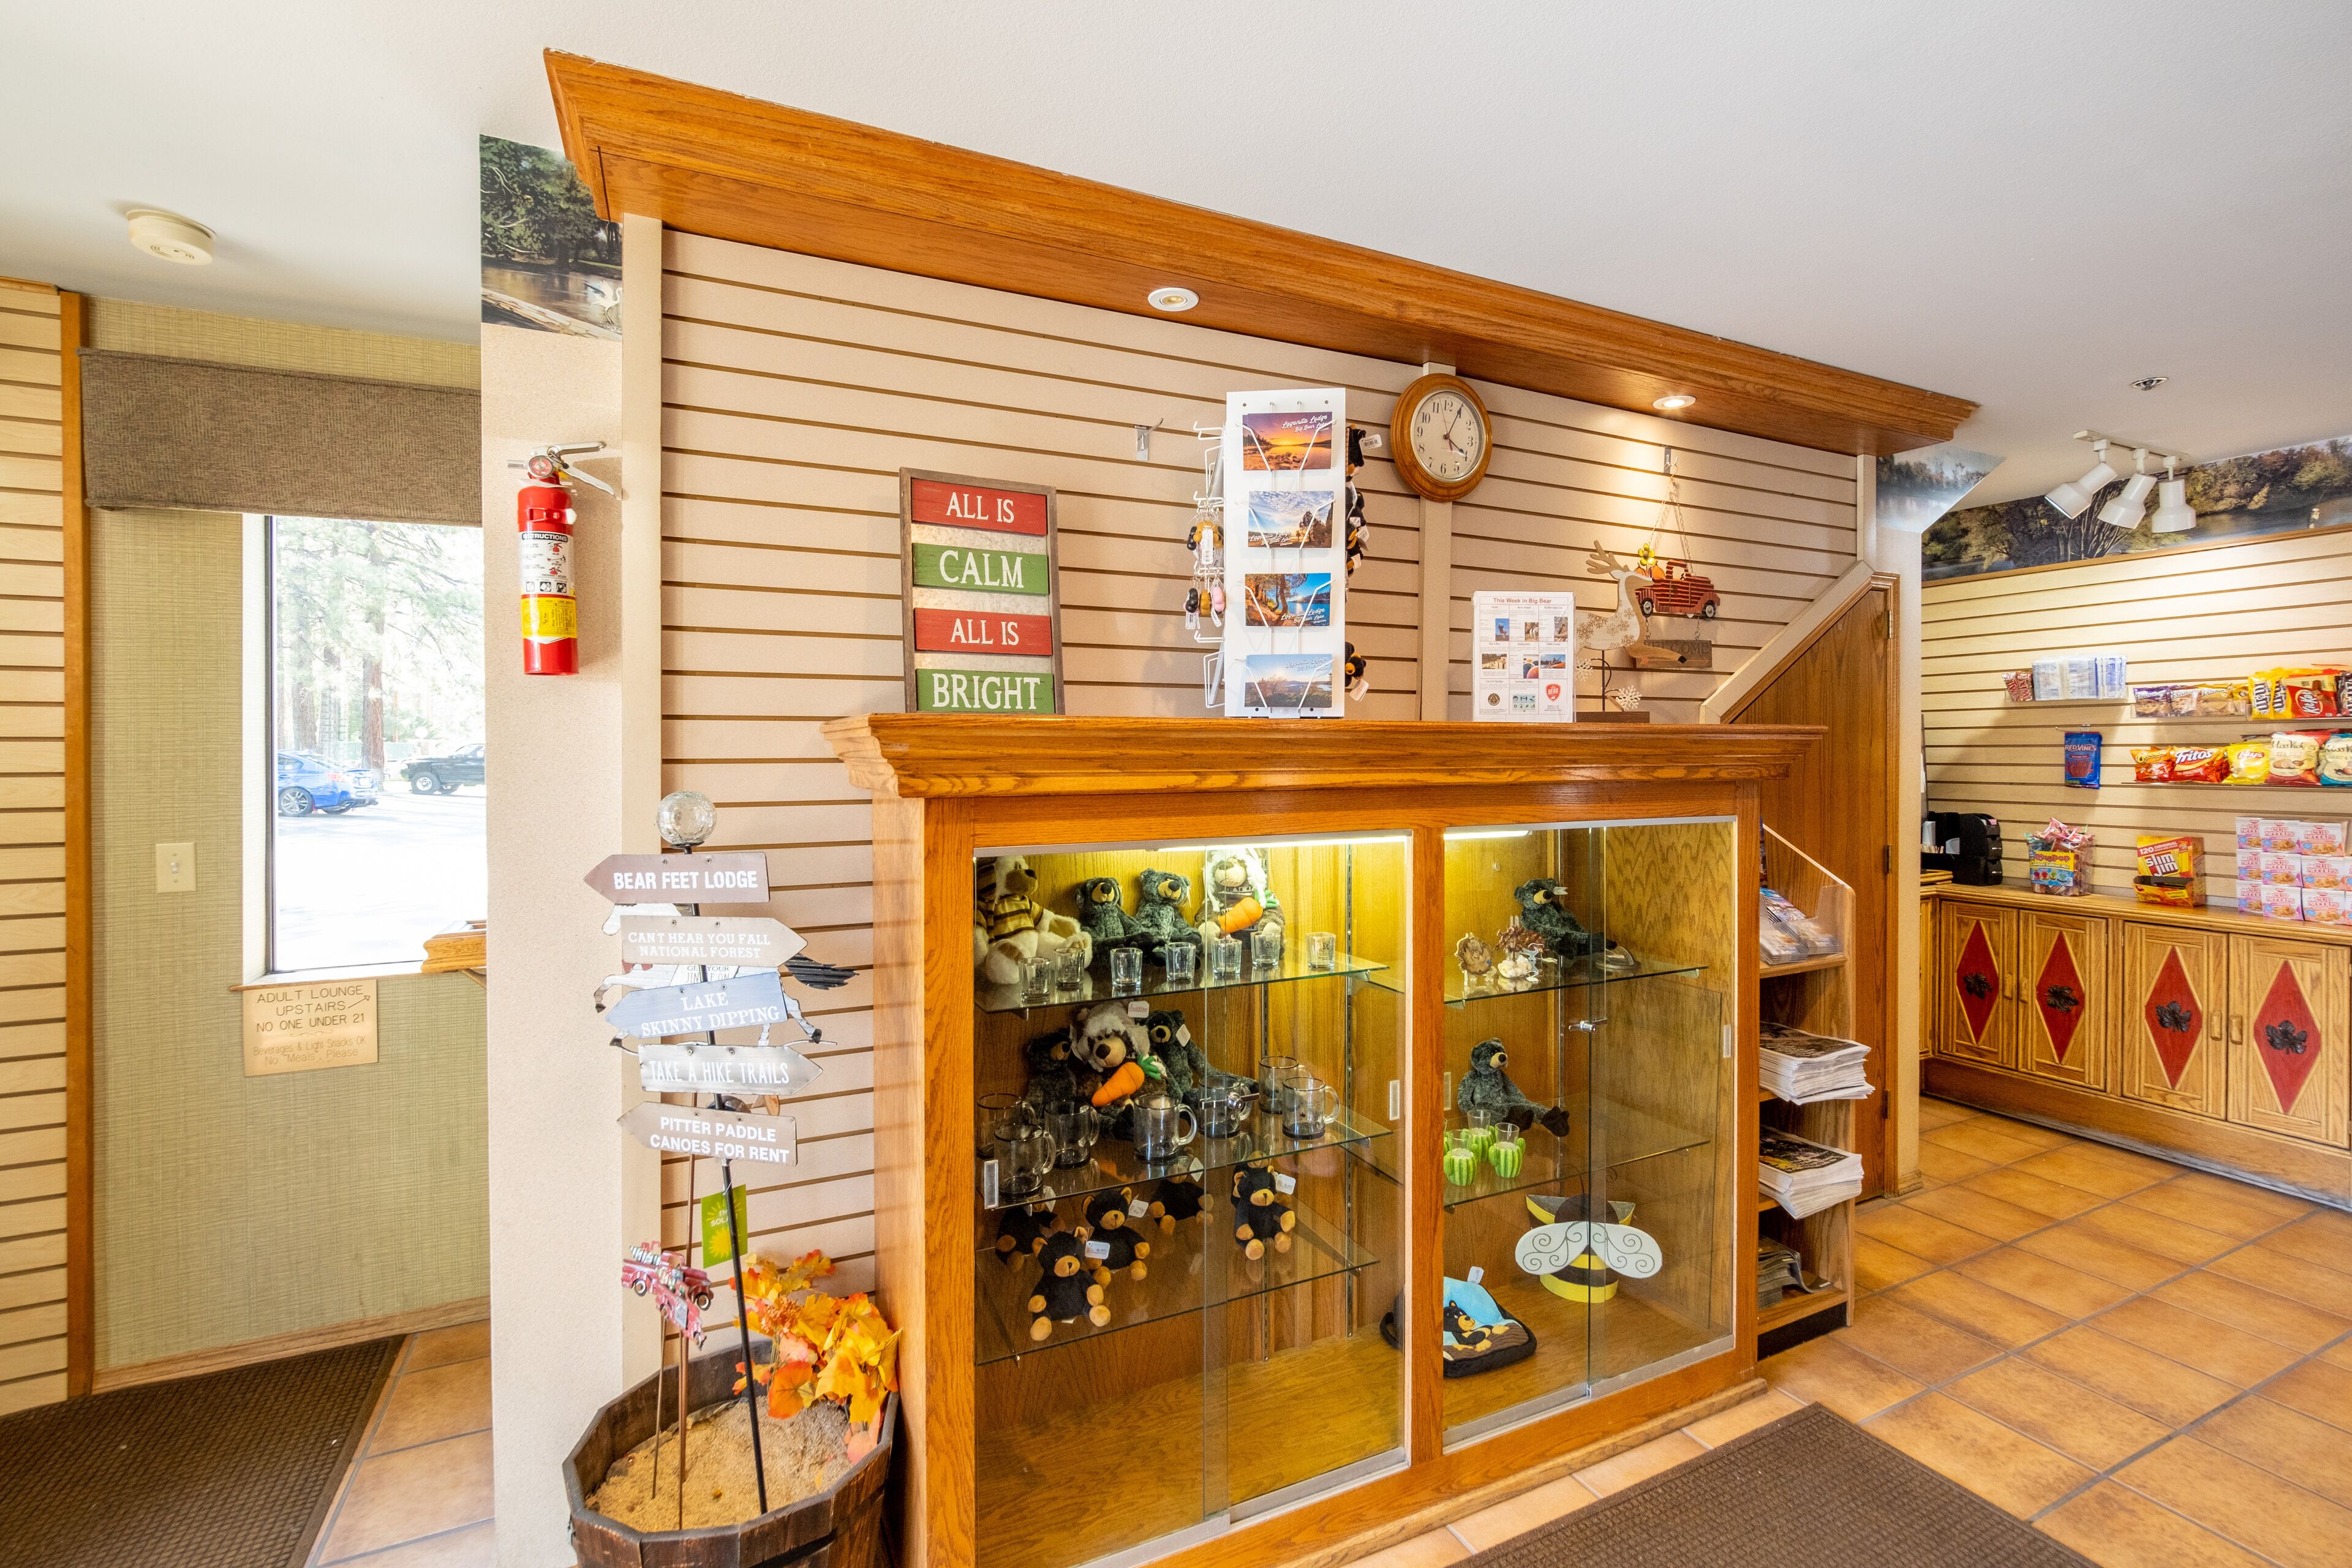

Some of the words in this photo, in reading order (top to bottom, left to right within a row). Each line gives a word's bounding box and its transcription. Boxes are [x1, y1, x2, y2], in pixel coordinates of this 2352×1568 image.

[1433, 402, 1439, 413] 11
[1444, 400, 1453, 412] 12
[1421, 412, 1431, 424] 10
[1466, 420, 1471, 430] 2
[1417, 426, 1423, 437] 9
[1419, 443, 1425, 454] 8
[1467, 436, 1473, 447] 3
[1428, 457, 1433, 468] 7
[1440, 463, 1446, 474] 6
[1454, 461, 1459, 472] 5
[945, 492, 989, 520] ALL
[997, 498, 1014, 523] IS
[939, 550, 1024, 589] CALM
[950, 618, 993, 646] ALL
[1001, 621, 1019, 646] IS
[932, 673, 1040, 710] BRIGHT
[2175, 750, 2213, 764] Fritos
[2139, 846, 2154, 855] 120
[614, 872, 656, 889] BEAR
[662, 871, 699, 889] FEET
[704, 870, 758, 889] LODGE
[628, 930, 666, 944] CAN'T
[668, 933, 705, 945] HEAR
[707, 933, 735, 945] YOU
[738, 933, 771, 946] FALL
[639, 945, 707, 958] NATIONAL
[710, 946, 761, 959] FOREST
[686, 973, 715, 983] JINE
[257, 990, 304, 1003] ADULT
[311, 985, 363, 999] LOUNGE
[680, 992, 729, 1011] LAKE
[276, 1001, 345, 1016] UPSTAIRS
[257, 1022, 273, 1032] NO
[279, 1019, 303, 1030] ONE
[309, 1014, 347, 1027] UNDER
[353, 1012, 364, 1023] 21
[640, 1016, 704, 1037] SKINNY
[709, 1006, 780, 1028] DIPPING
[254, 1046, 293, 1056] Beverages
[307, 1040, 323, 1053] Light
[326, 1037, 353, 1049] Snacks
[265, 1056, 278, 1066] No
[326, 1049, 358, 1059] Please
[650, 1061, 682, 1083] TAKE
[688, 1061, 697, 1082] A
[703, 1061, 733, 1084] HIKE
[739, 1061, 790, 1084] TRAILS
[660, 1117, 711, 1135] PITTER
[715, 1122, 776, 1142] PADDLE
[650, 1135, 711, 1155] CANOES
[715, 1141, 746, 1158] FOR
[750, 1146, 790, 1164] RENT
